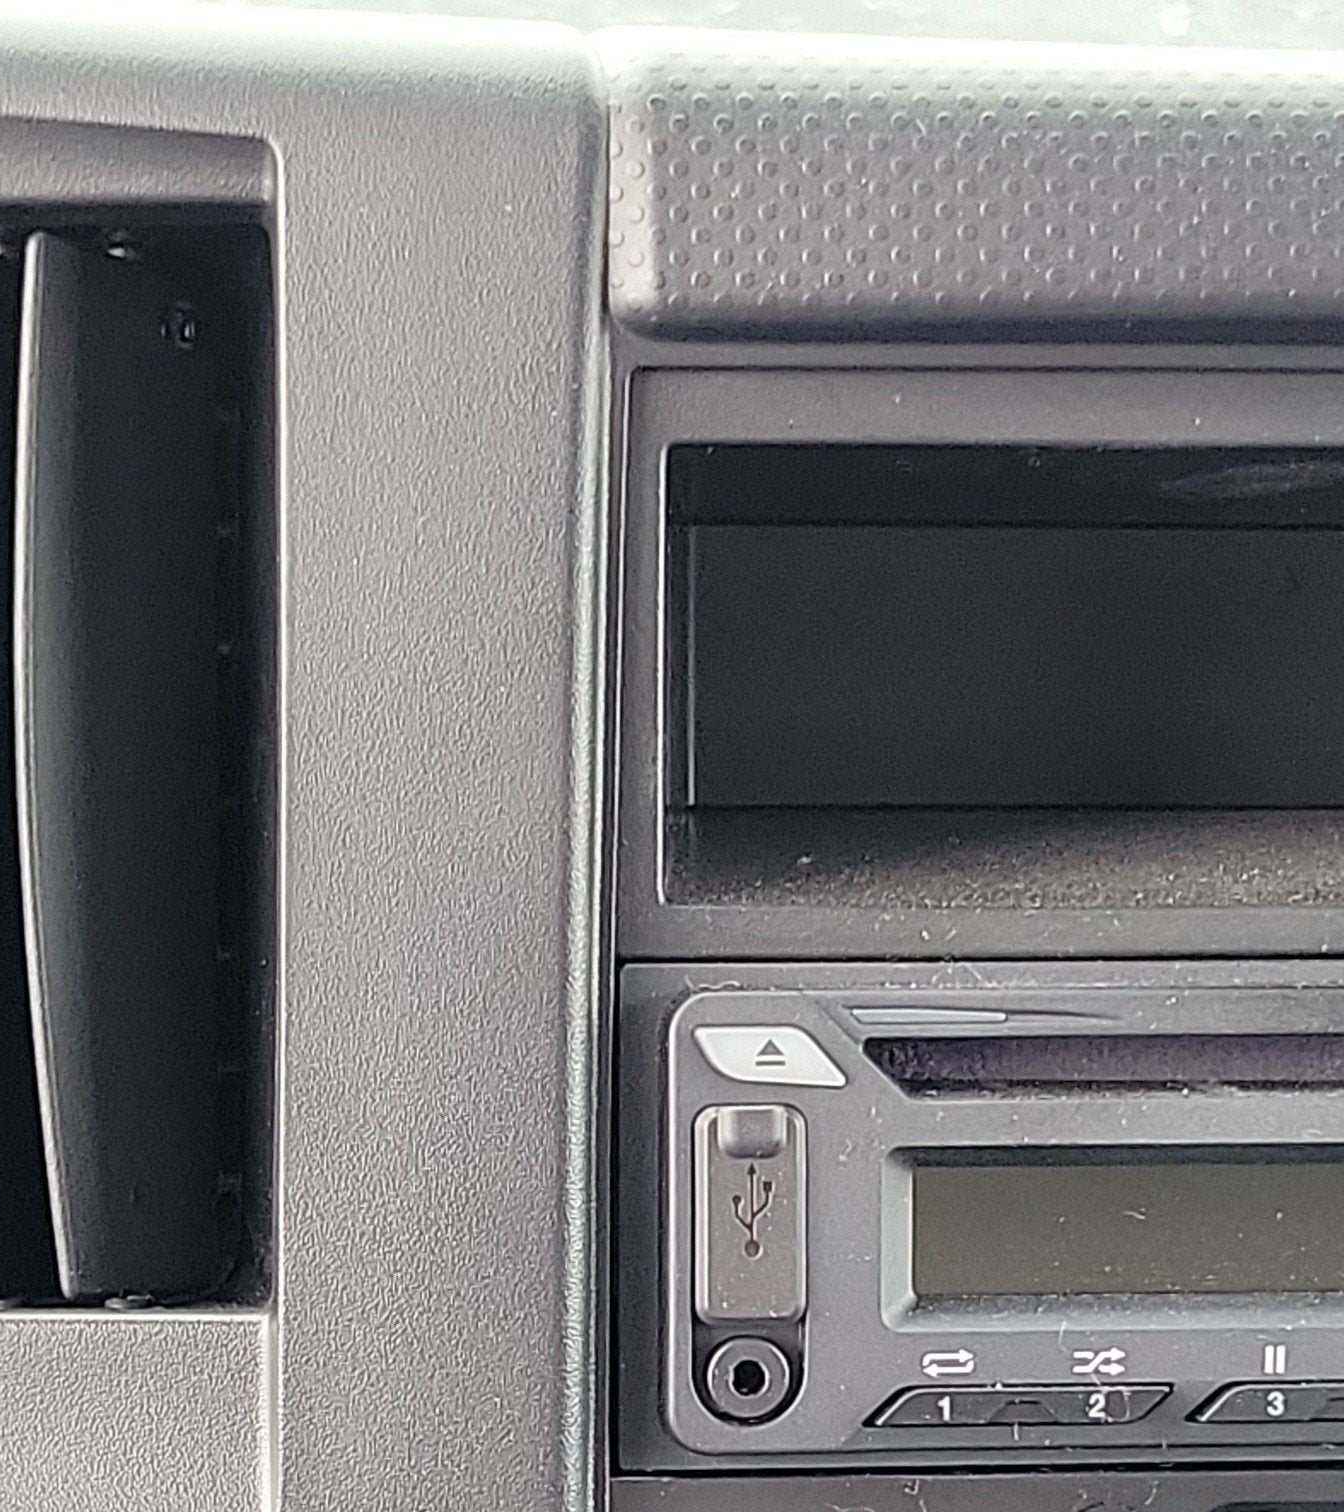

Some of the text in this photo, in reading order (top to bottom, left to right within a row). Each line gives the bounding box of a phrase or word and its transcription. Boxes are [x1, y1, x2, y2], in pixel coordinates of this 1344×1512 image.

[936, 1395, 951, 1421] 1
[1087, 1391, 1106, 1418] 2
[1266, 1390, 1286, 1417] 3
